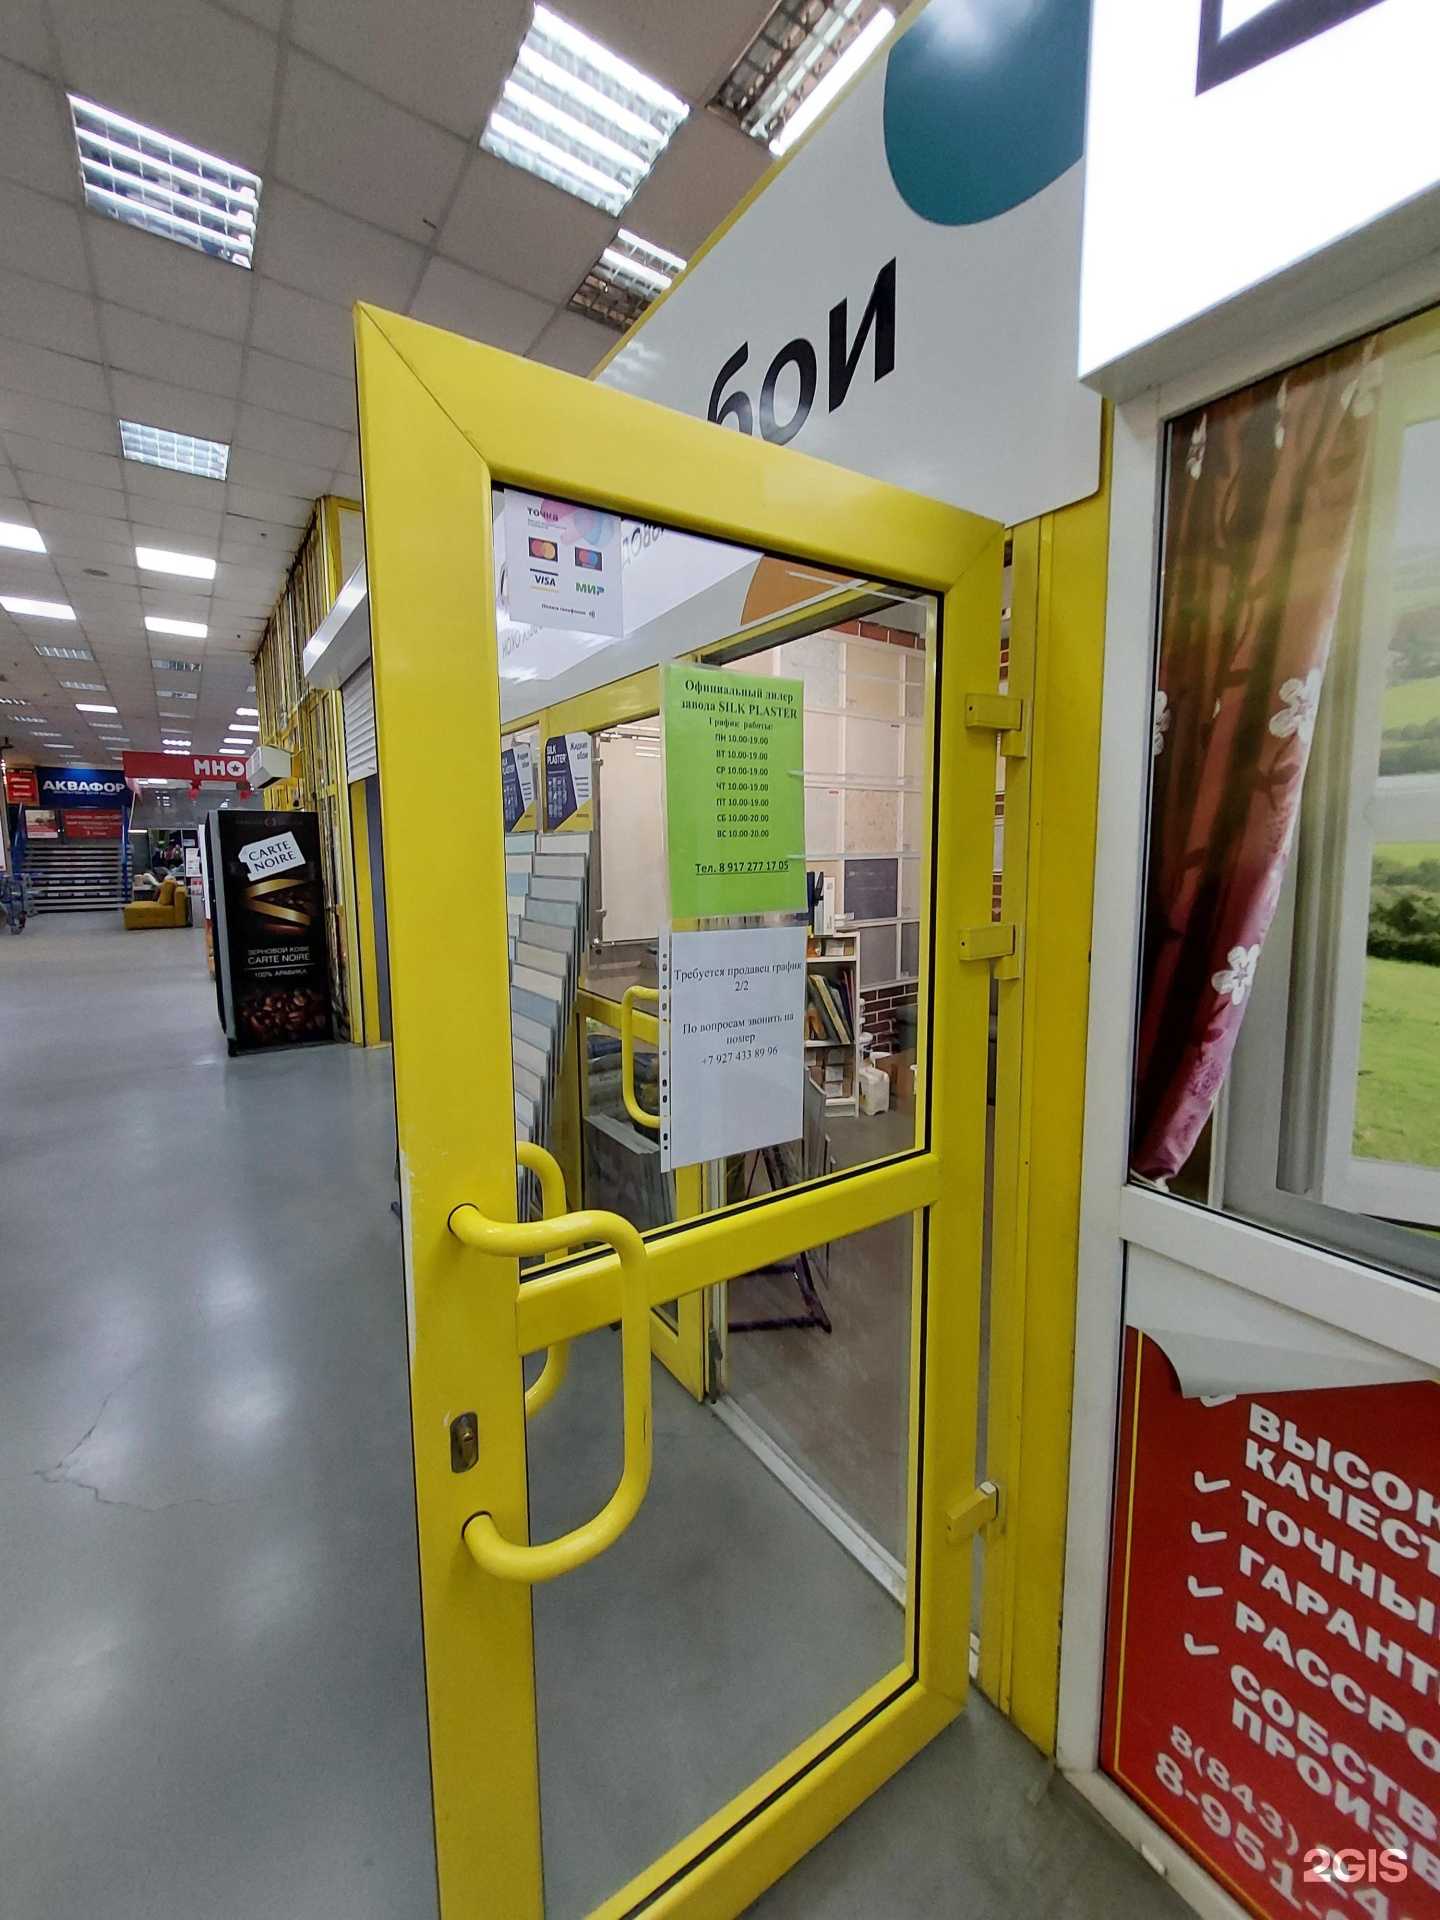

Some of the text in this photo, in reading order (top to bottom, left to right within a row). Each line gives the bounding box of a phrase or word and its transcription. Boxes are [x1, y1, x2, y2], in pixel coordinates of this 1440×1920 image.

[535, 575, 556, 587] VISA
[575, 582, 605, 596] МИР
[685, 679, 794, 705] Официальный дилер
[681, 700, 798, 719] завода SILK PLASTER
[715, 733, 769, 745] ПН 10.00-19.00
[716, 749, 769, 760] ВТ 10.00-19.00
[716, 766, 769, 776] СР 10.00-19.00
[43, 780, 125, 793] АКВАФОР
[716, 782, 769, 792] ЧТ 10.00-19.00
[716, 798, 769, 807] ПТ 10.00-19.00
[716, 814, 769, 823] СБ 10.00-20.00
[716, 829, 769, 838] ВС 10.00-20.00
[249, 840, 292, 861] CARTE
[254, 851, 297, 872] NOIRE
[695, 860, 789, 873] Тел. 8 917 277 17 05
[247, 952, 311, 965] CARTE NOIRE
[674, 961, 802, 982] Требуется продавец график
[734, 980, 749, 992] 2/2
[682, 1013, 794, 1035] По вопросам звонить на
[726, 1034, 756, 1045] номер
[702, 1046, 778, 1065] +7 927 433 89 96
[1235, 1601, 1440, 1774] РАССРО
[1230, 1664, 1438, 1841] СОБСТВ
[1170, 1725, 1299, 1856] 8(843)
[1232, 1698, 1440, 1893] ПРОИЗВ
